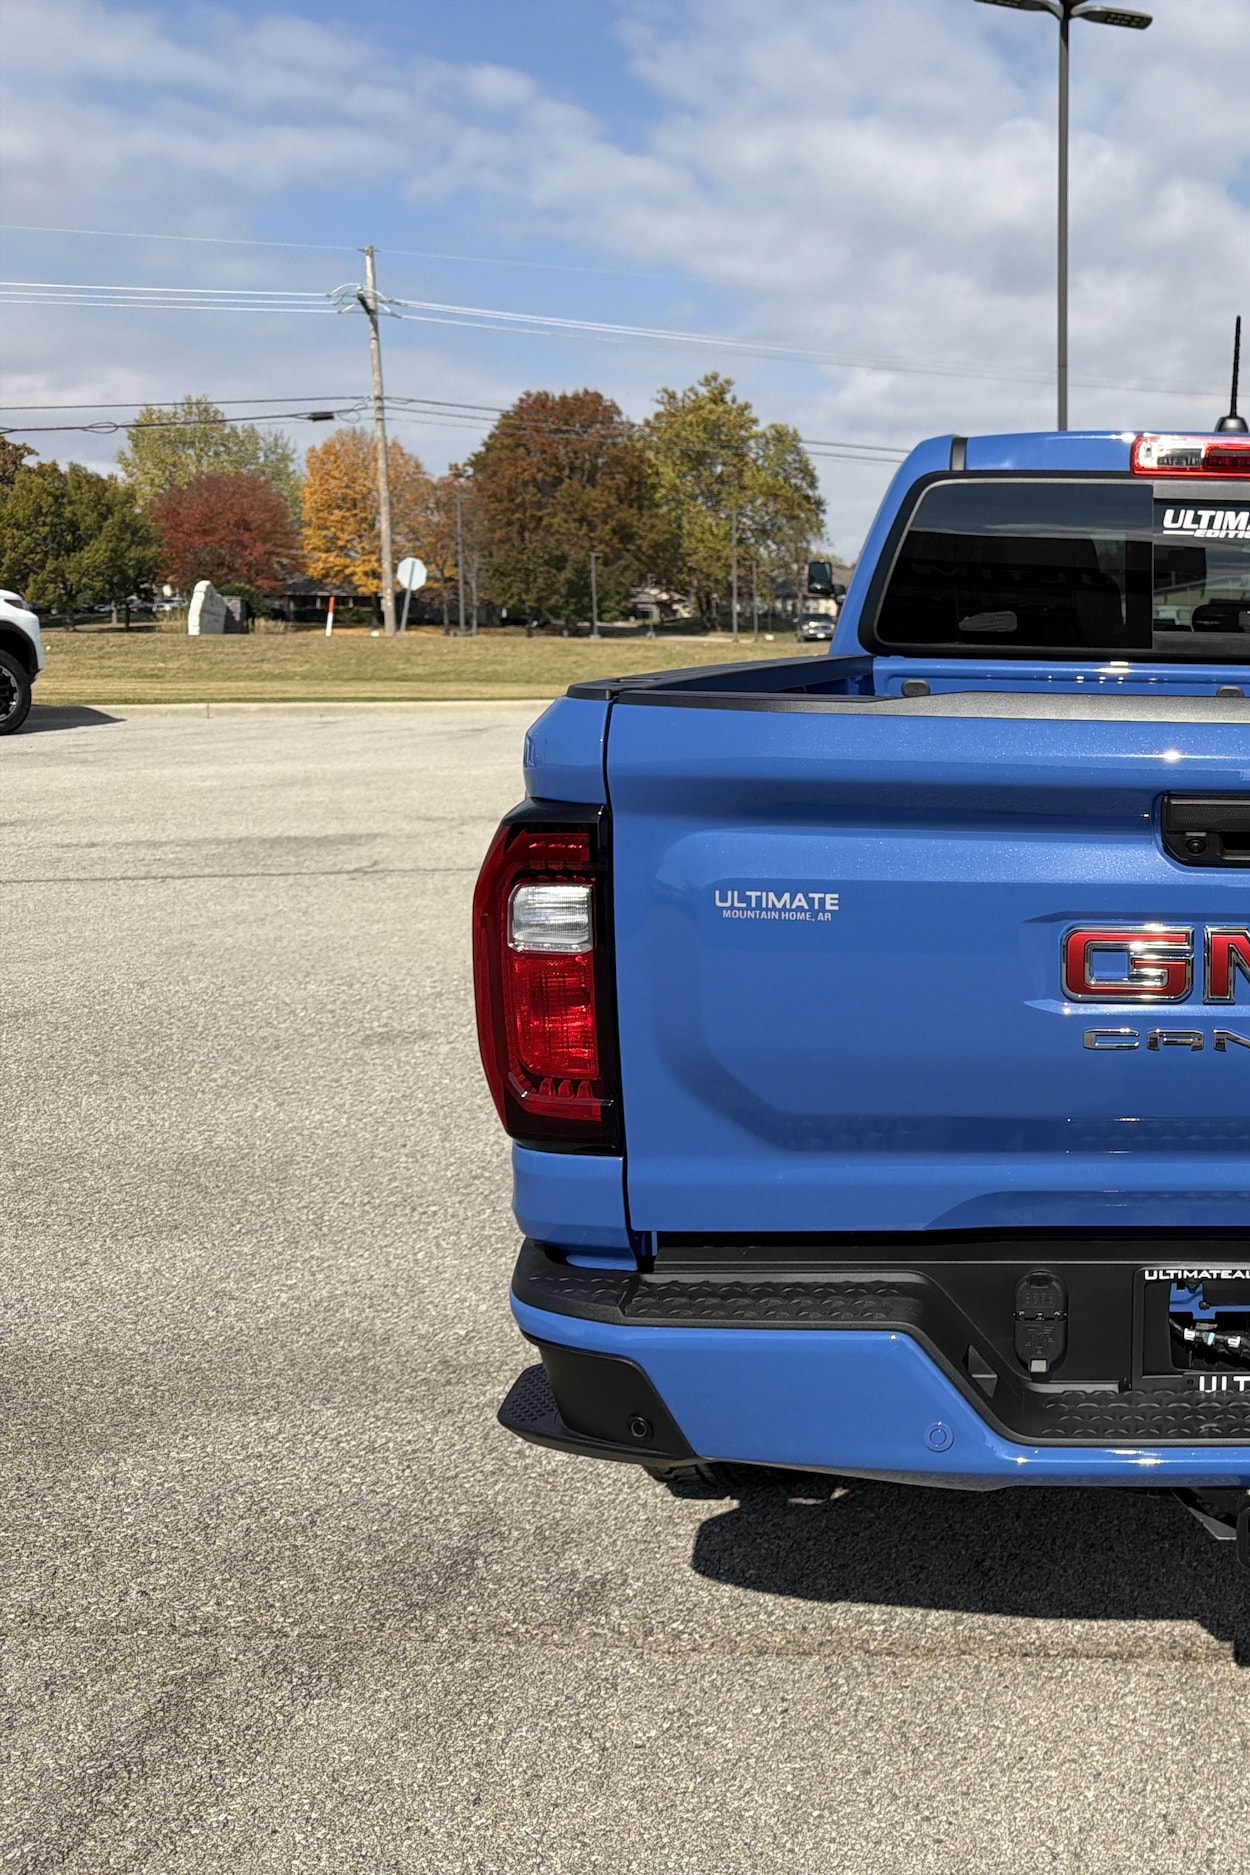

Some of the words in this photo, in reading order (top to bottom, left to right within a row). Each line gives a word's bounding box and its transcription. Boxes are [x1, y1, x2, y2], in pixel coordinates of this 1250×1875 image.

[714, 890, 840, 911] ULTIMATE
[722, 909, 779, 921] MOUNTAIN
[781, 911, 816, 922] HOME,
[817, 912, 832, 922] AR
